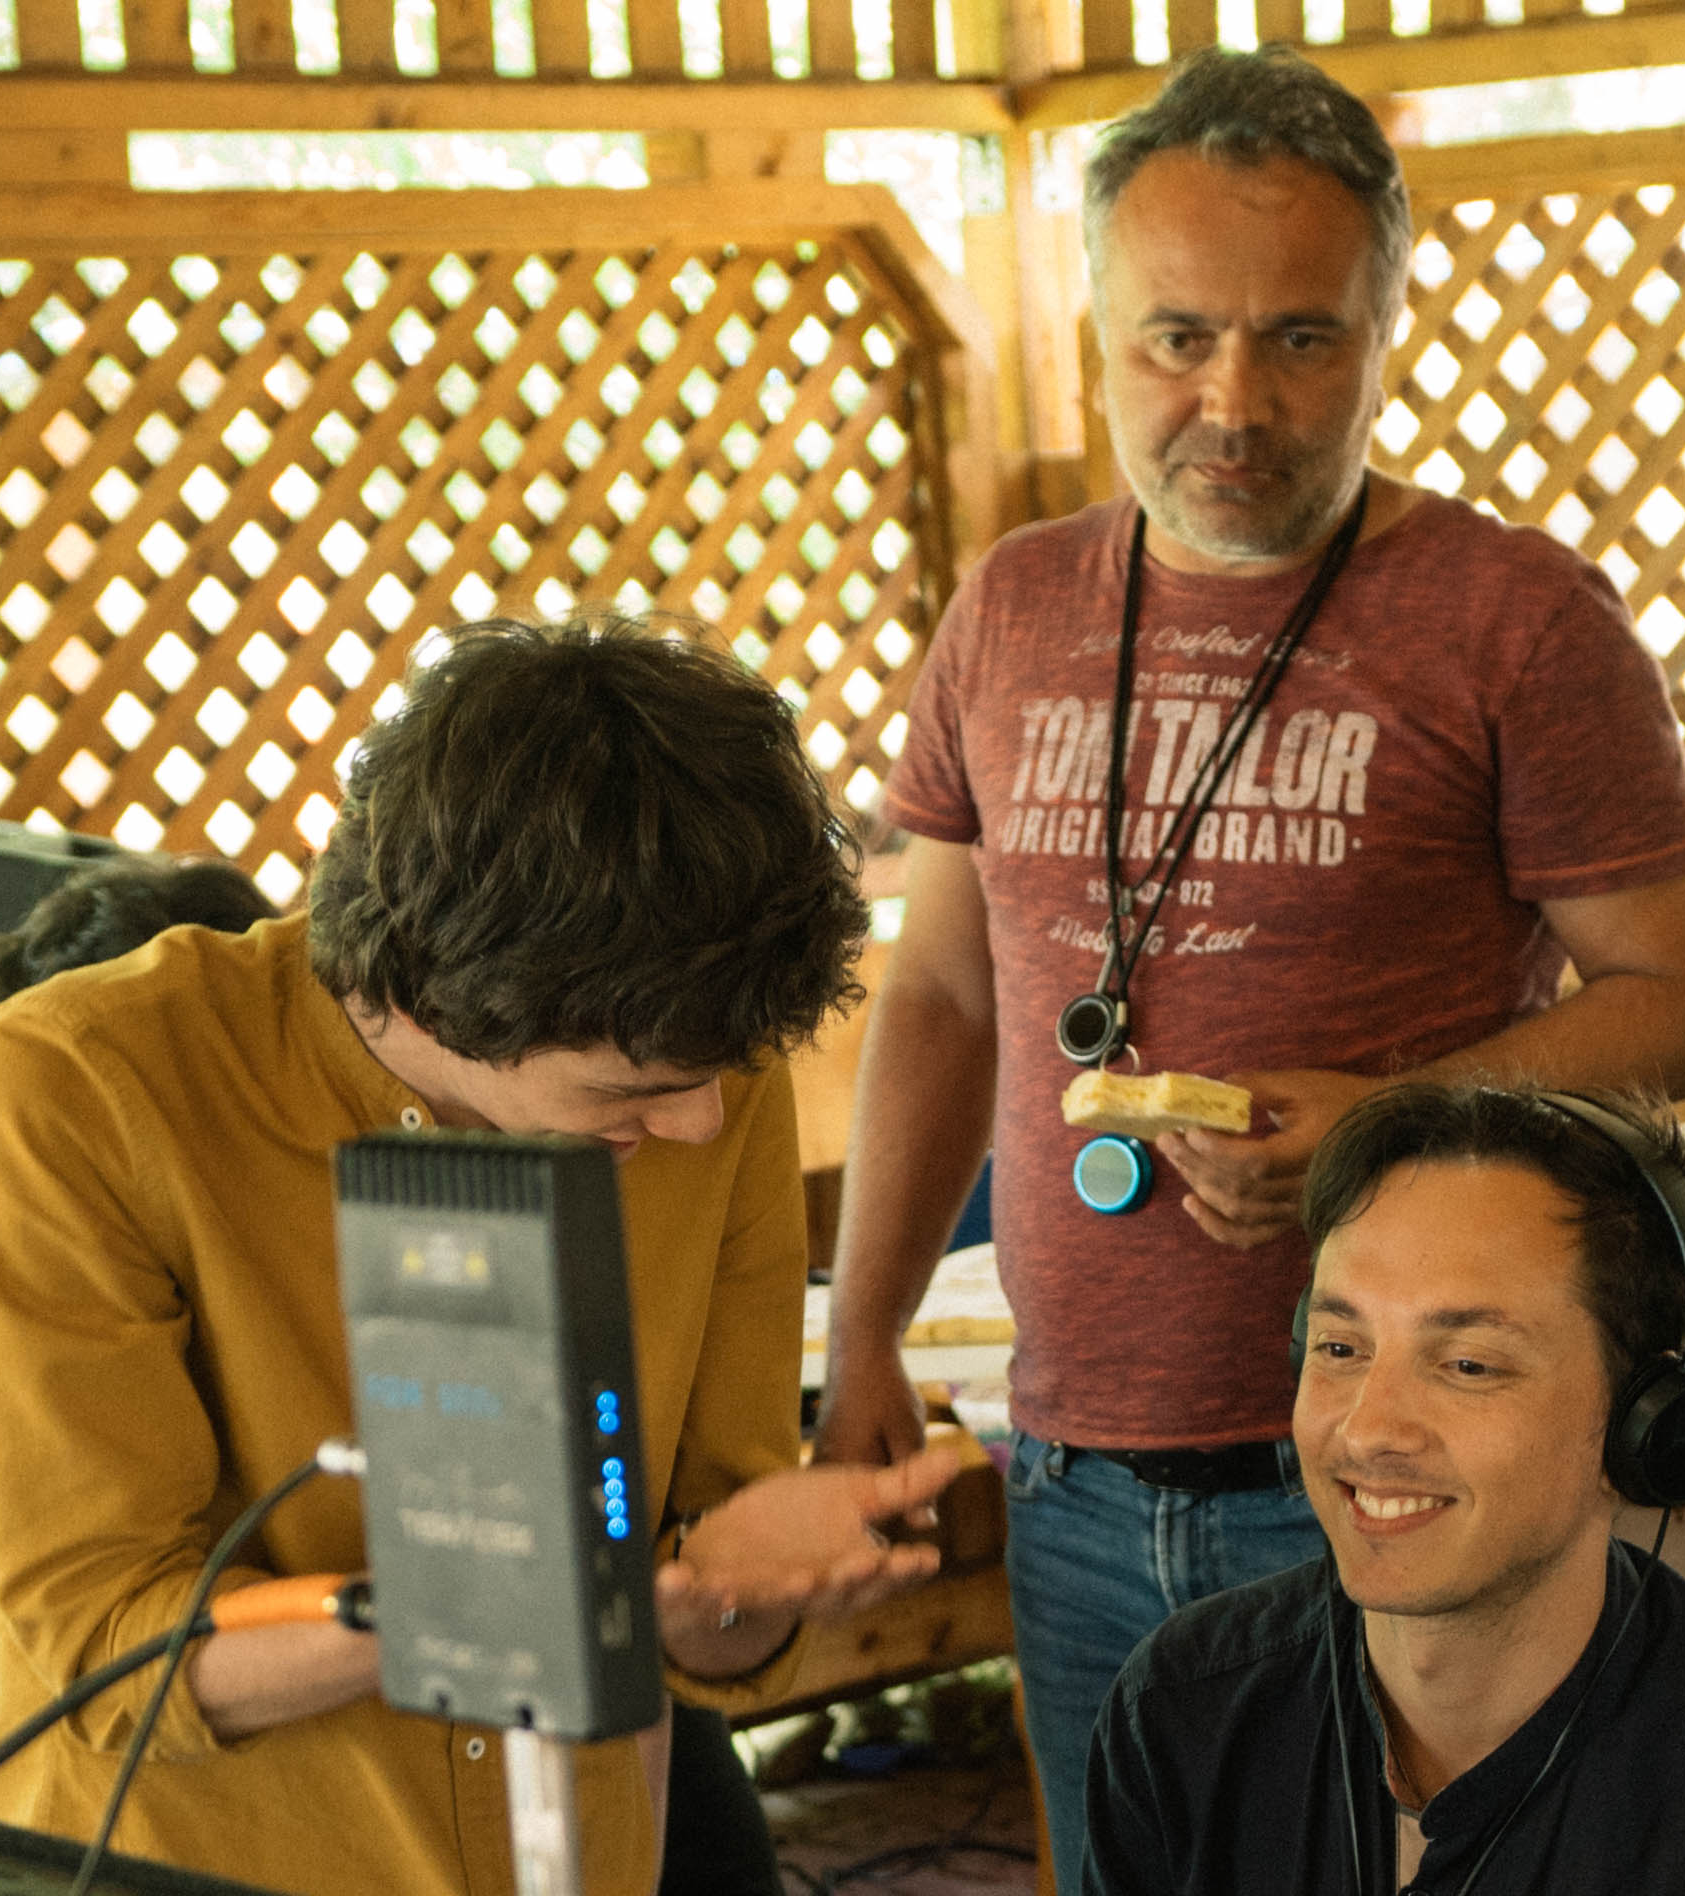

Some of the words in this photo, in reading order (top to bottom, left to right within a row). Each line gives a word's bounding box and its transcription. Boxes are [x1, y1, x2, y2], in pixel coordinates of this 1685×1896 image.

[1011, 696, 1143, 803] TOM
[1144, 699, 1378, 816] TAILOR
[1193, 810, 1347, 867] BRAND
